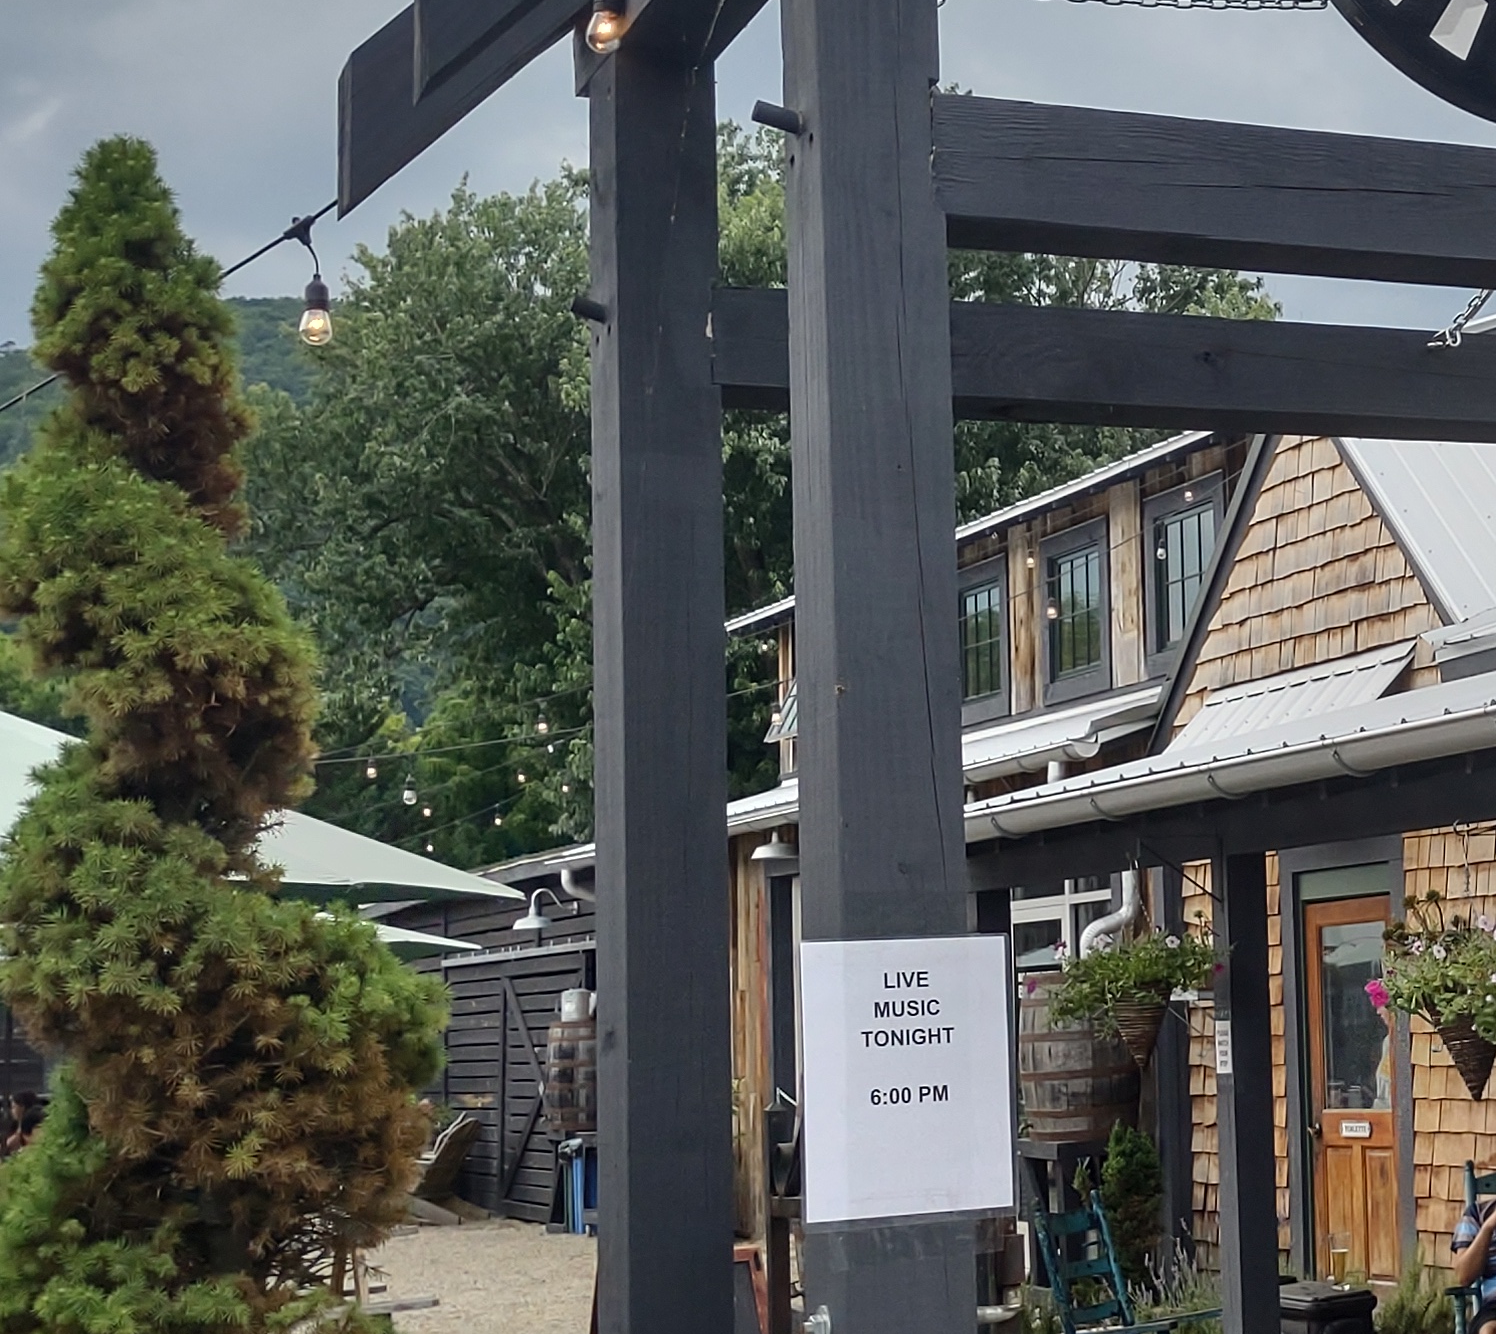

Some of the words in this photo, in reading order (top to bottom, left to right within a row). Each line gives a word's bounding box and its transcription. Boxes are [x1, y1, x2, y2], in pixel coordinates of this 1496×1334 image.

[884, 971, 929, 989] LIVE
[874, 999, 940, 1018] MUSIC
[861, 1027, 955, 1048] TONIGHT
[870, 1087, 912, 1105] 6:00
[919, 1085, 949, 1103] PM
